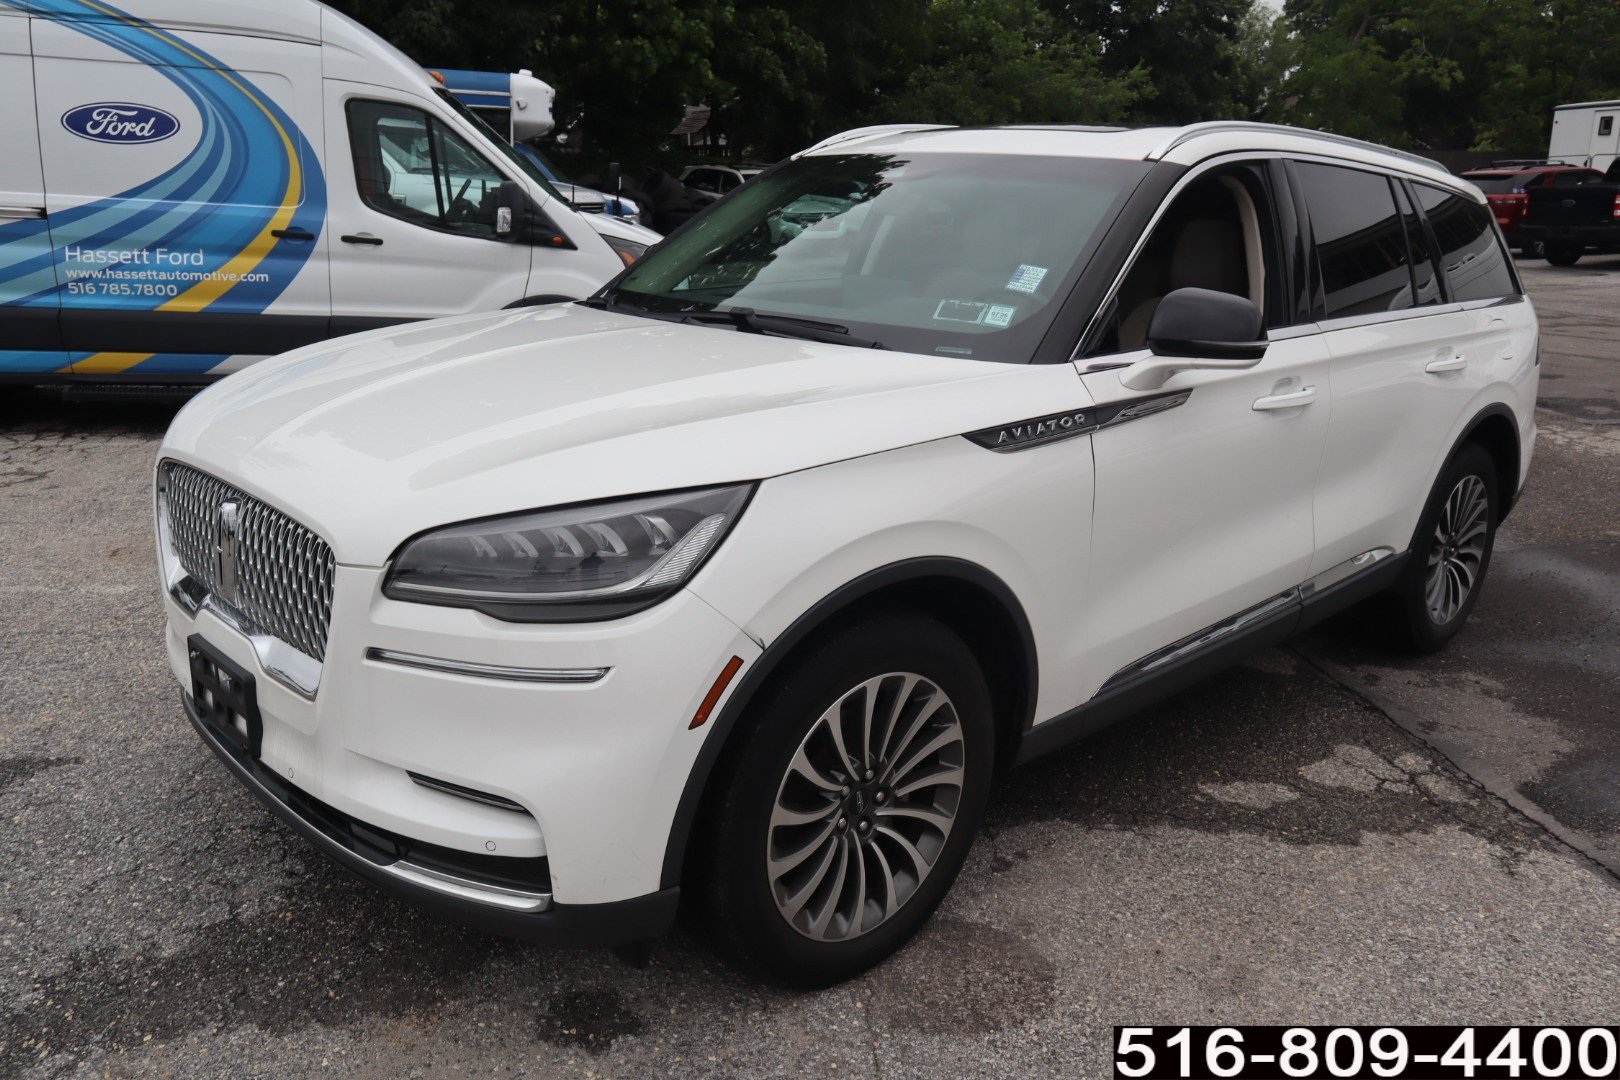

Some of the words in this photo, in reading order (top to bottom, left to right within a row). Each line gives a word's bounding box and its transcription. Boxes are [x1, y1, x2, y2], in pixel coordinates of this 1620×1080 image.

[86, 108, 156, 136] Ford
[65, 246, 149, 265] Hassett
[156, 248, 204, 266] Ford
[65, 268, 269, 282] www.hassettautomotive.com
[68, 283, 96, 295] 516
[99, 283, 178, 296] 785.7800
[997, 413, 1086, 444] AVIATOR
